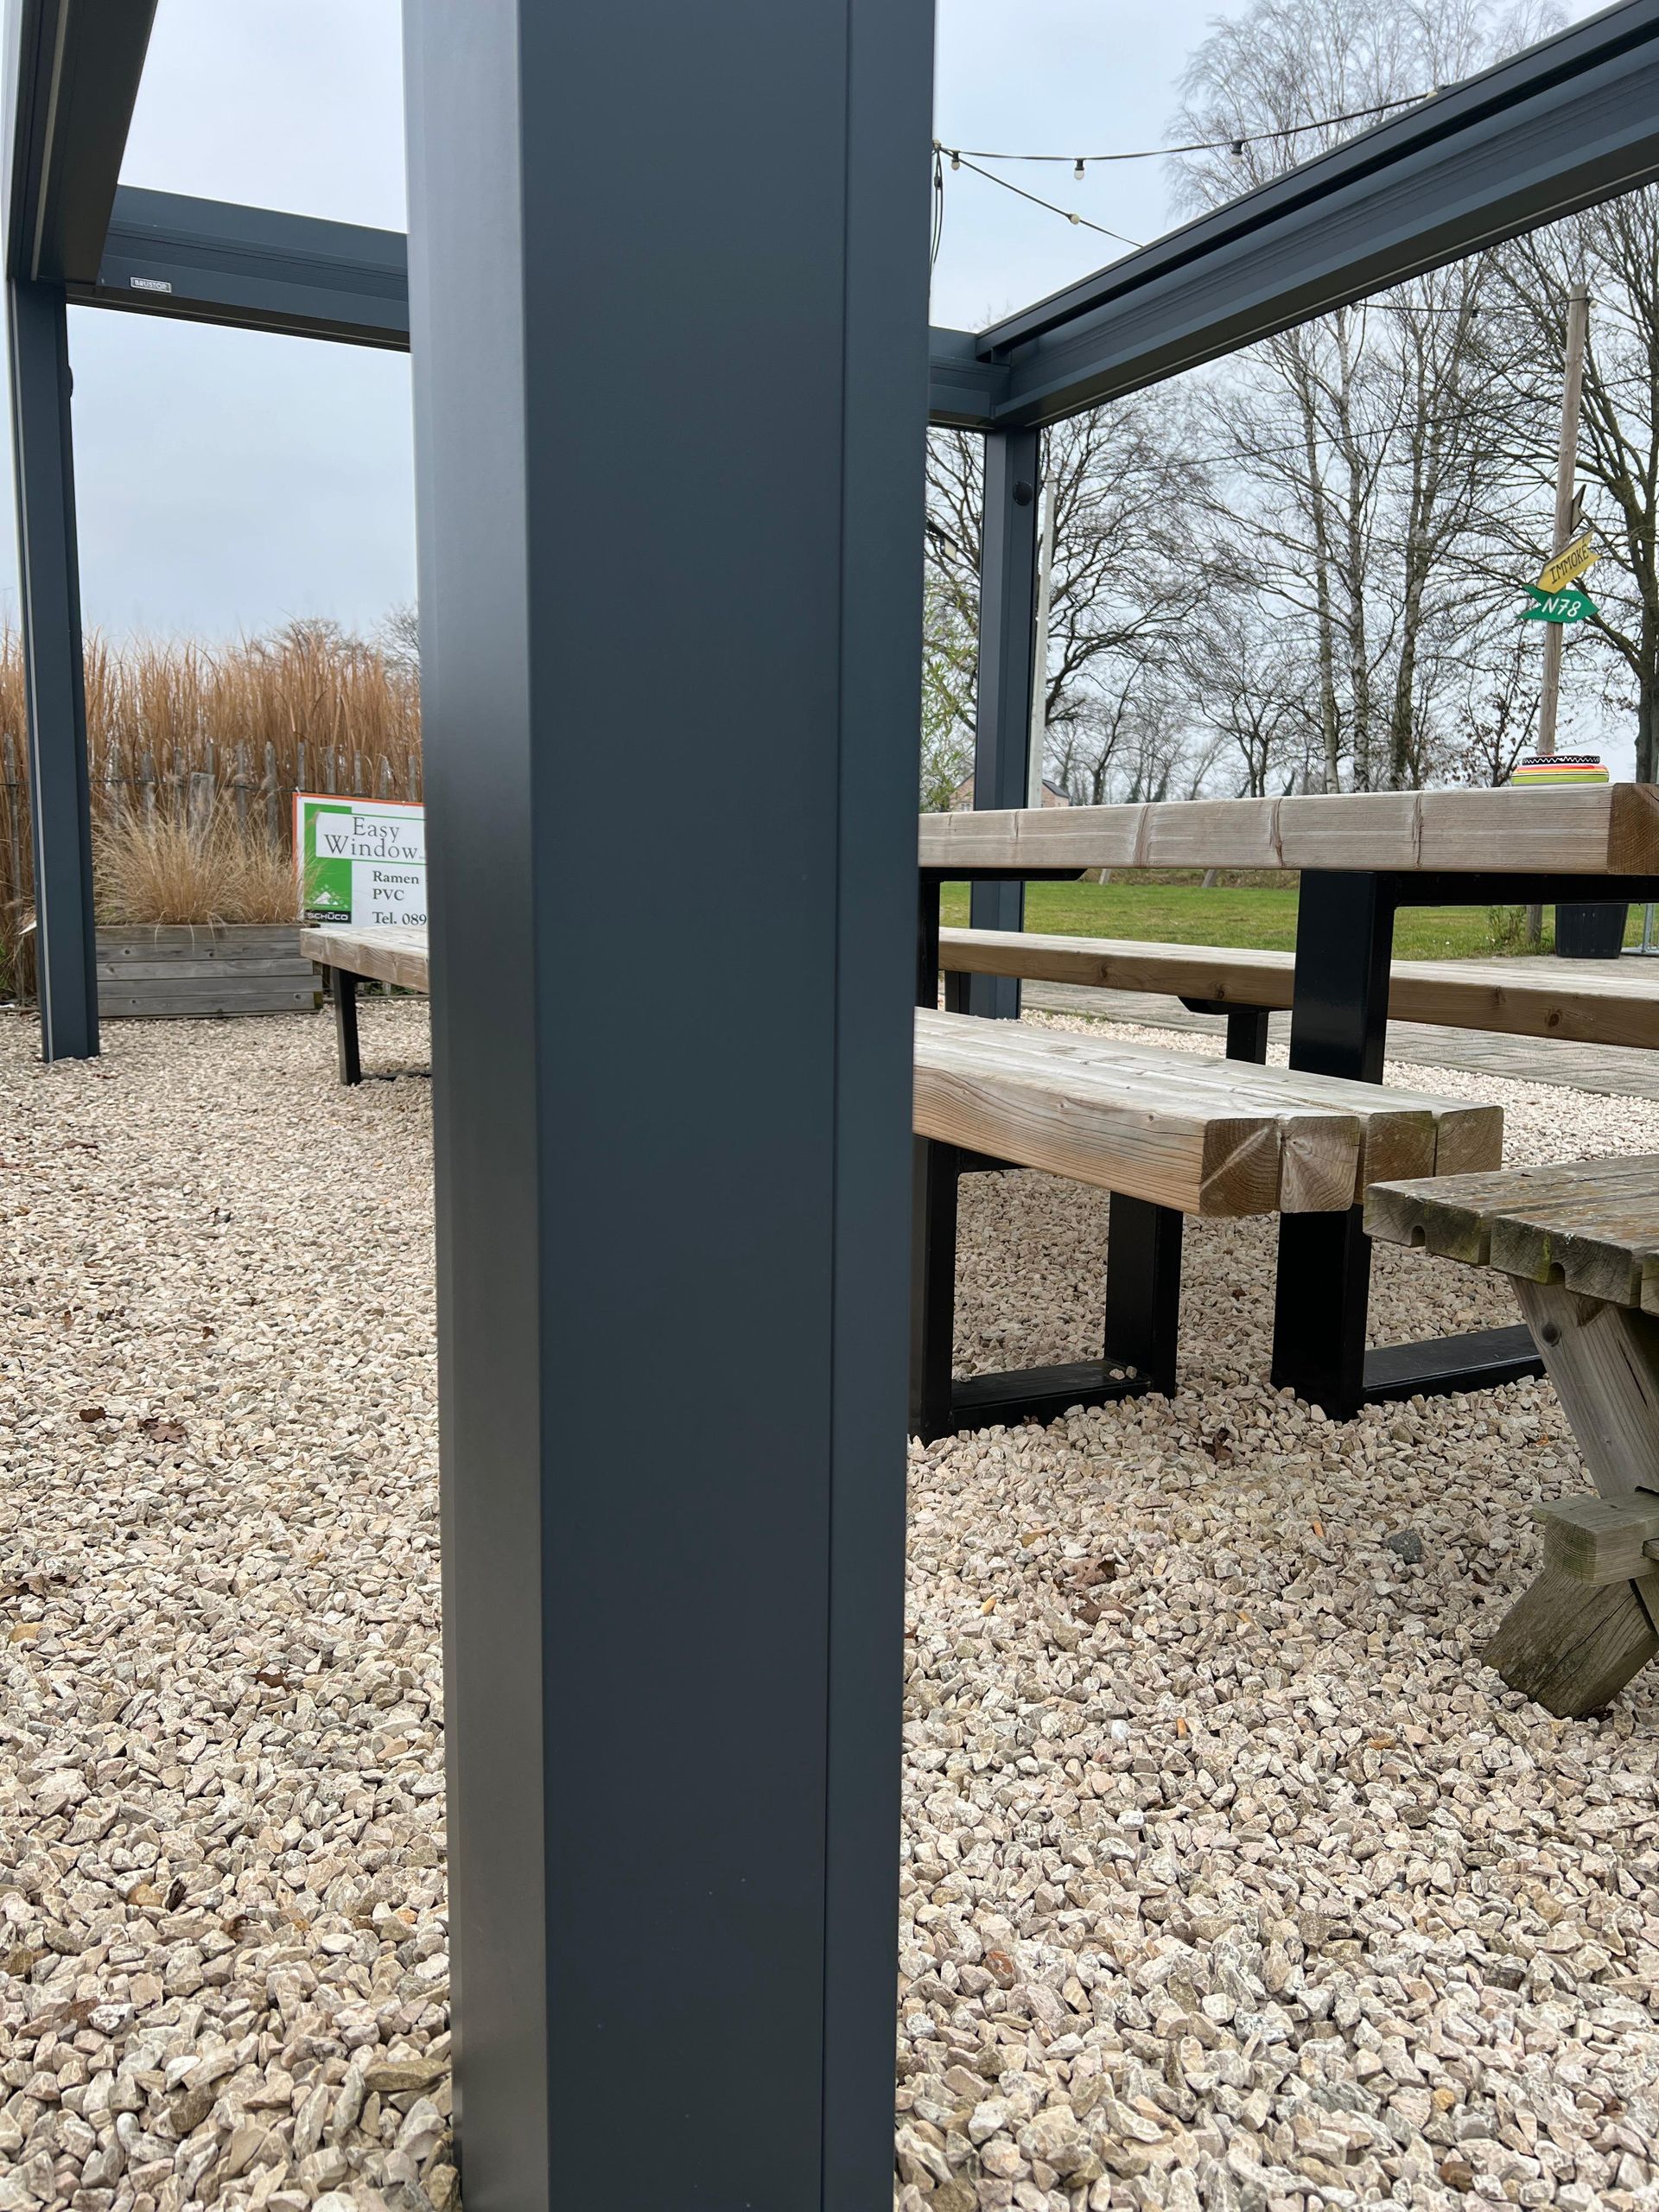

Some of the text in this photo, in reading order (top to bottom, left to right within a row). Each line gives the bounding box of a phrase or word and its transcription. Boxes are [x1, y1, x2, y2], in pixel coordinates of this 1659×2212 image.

[134, 279, 167, 290] BRUSTOR
[1541, 597, 1581, 617] N78
[353, 817, 400, 842] Easy
[324, 834, 418, 860] Window
[372, 870, 419, 885] Ramen
[372, 888, 404, 900] PVC
[307, 912, 348, 921] SCHÜCO
[372, 911, 397, 925] Tel.
